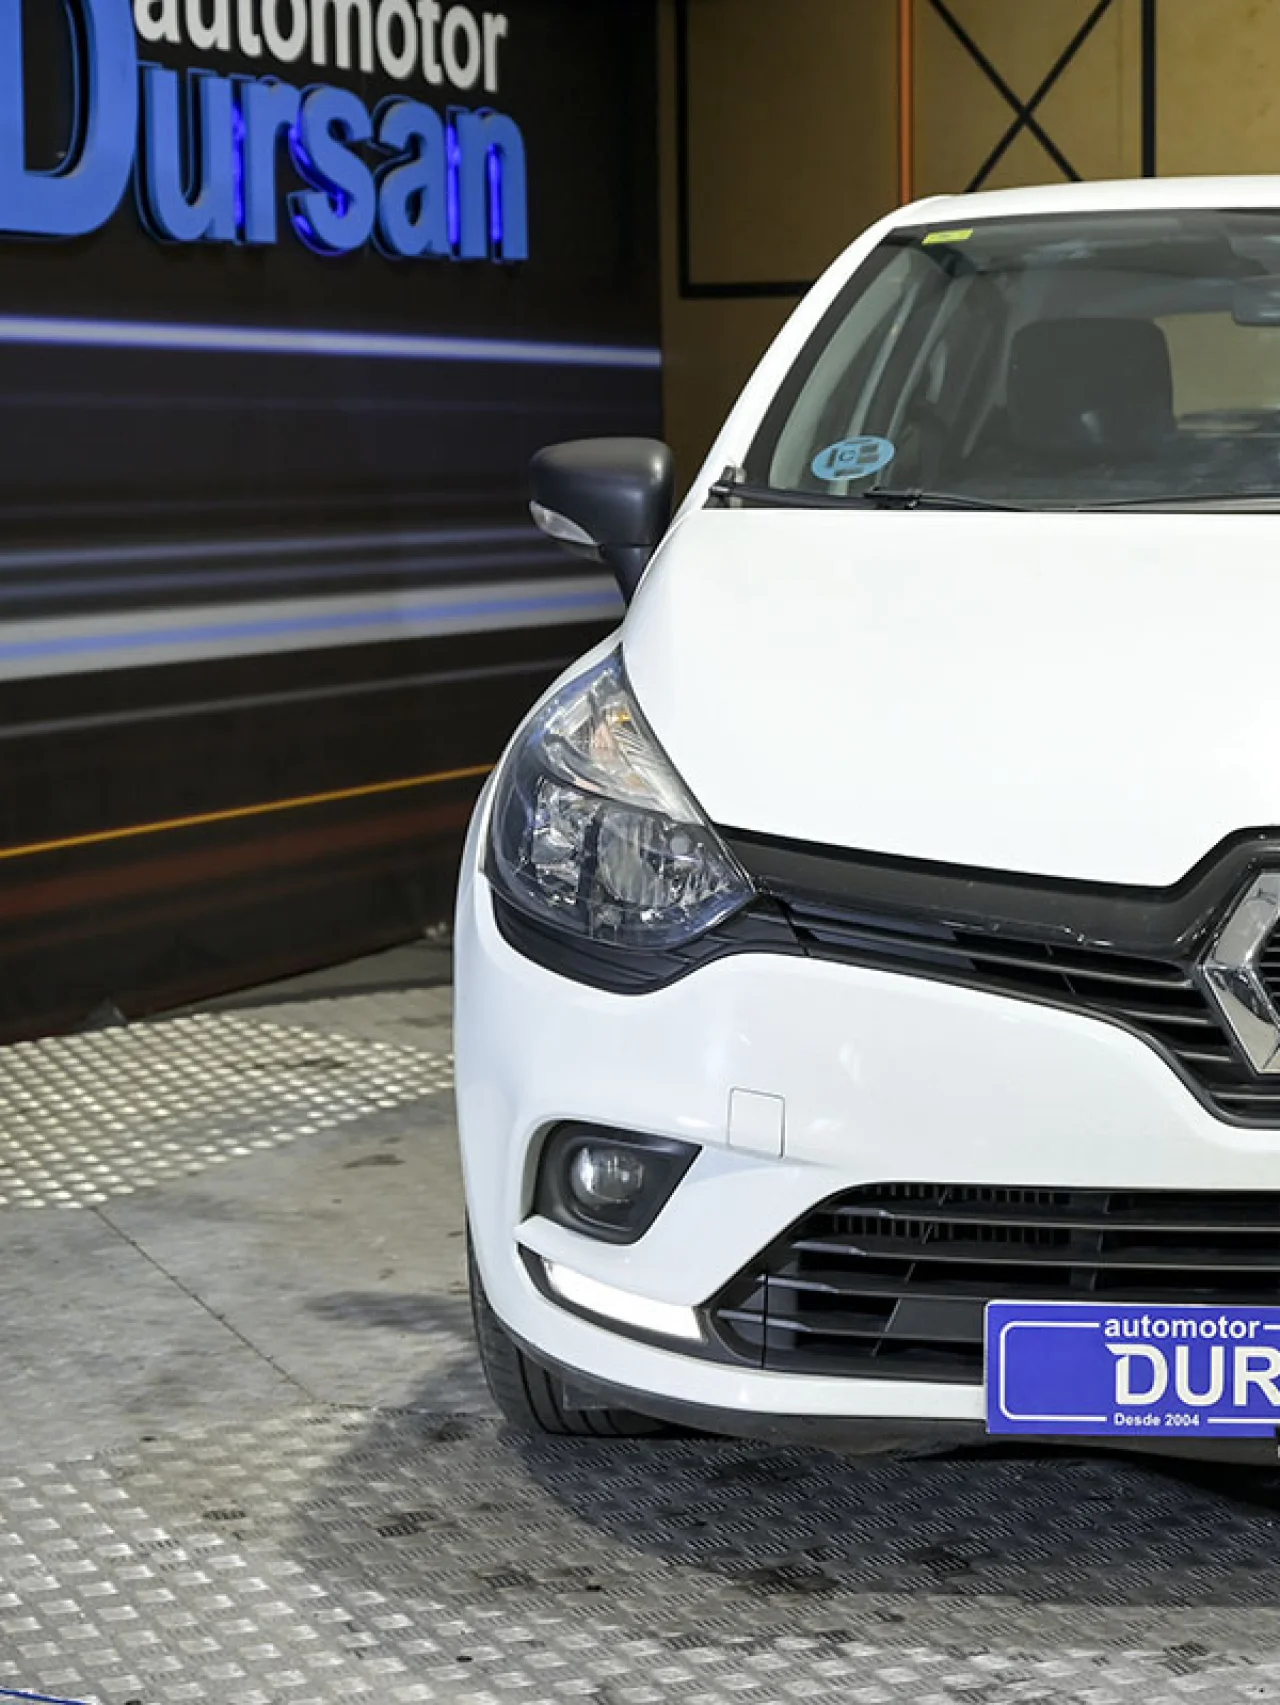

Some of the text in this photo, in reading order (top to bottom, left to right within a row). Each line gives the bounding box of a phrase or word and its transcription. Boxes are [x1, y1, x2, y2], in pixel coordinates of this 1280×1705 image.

[0, 0, 529, 259] Dursan
[1104, 1314, 1261, 1338] automotor
[1113, 1412, 1200, 1427] Desde 2004
